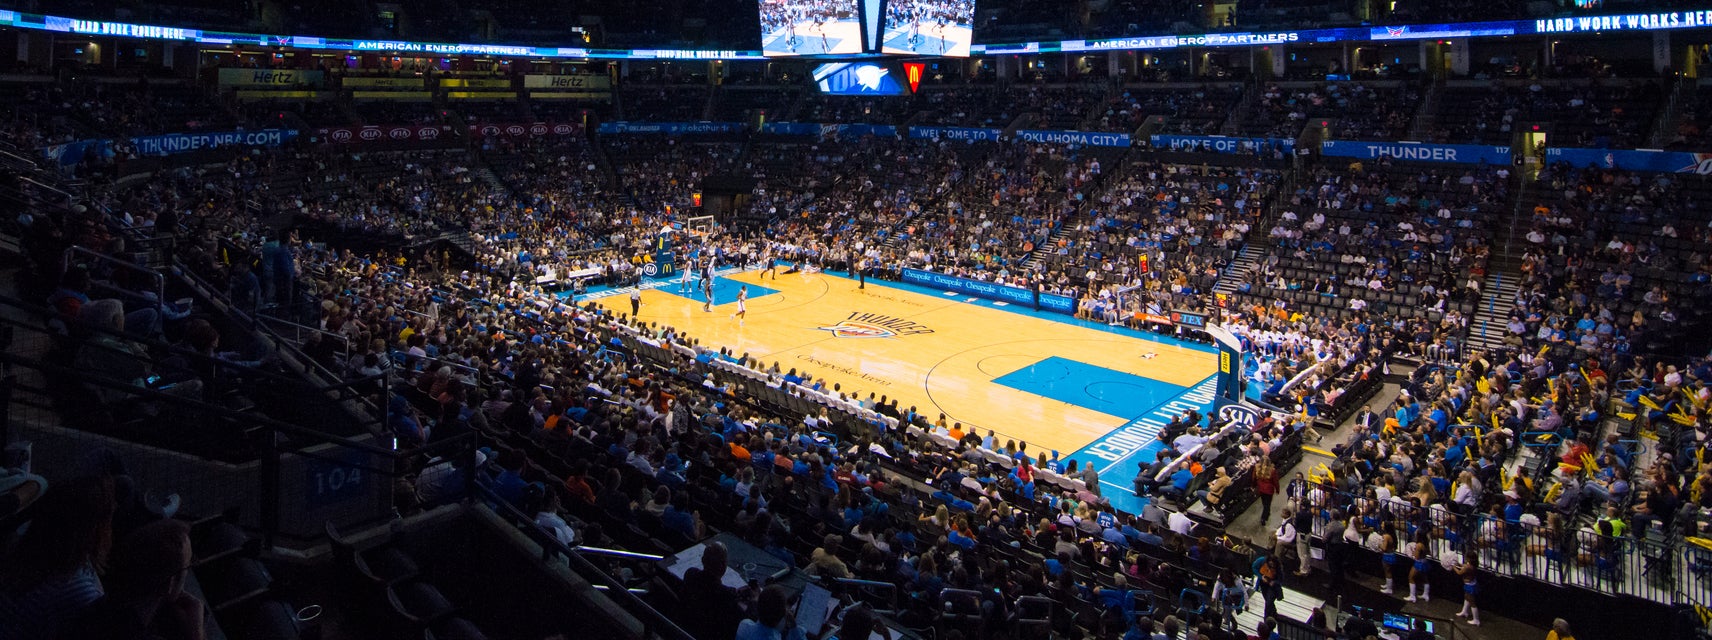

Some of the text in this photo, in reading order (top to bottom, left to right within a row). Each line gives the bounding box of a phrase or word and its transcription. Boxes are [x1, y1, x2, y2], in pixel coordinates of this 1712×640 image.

[74, 20, 99, 33] HARD
[102, 22, 128, 35] WORK
[131, 24, 161, 38] WORKS
[1537, 19, 1573, 32] HARD
[1579, 16, 1620, 30] WORK
[1627, 13, 1678, 28] WORKS
[358, 41, 527, 55] AMERICAN ENERGY PARTNERS
[1093, 33, 1298, 49] AMERICAN ENERGY PARTNERS
[253, 71, 292, 84] Hertz
[551, 76, 583, 87] Hertz
[920, 129, 988, 140] WELOME TO
[1023, 132, 1119, 146] OKLAHOMA CITY
[1171, 138, 1211, 151] HOME
[1215, 140, 1236, 152] OF
[1496, 146, 1510, 154] 117
[1367, 145, 1457, 161] THUNDER
[904, 270, 932, 282] Chesapeake
[934, 275, 963, 289] Chesapeake
[965, 281, 997, 296] Chesapeake
[999, 287, 1032, 300] Chesapeake
[1040, 294, 1071, 308] hesapeake
[847, 311, 935, 336] THUNDER
[1222, 353, 1230, 371] Hertz
[1084, 417, 1167, 461] THUNDER
[315, 467, 361, 496] 104
